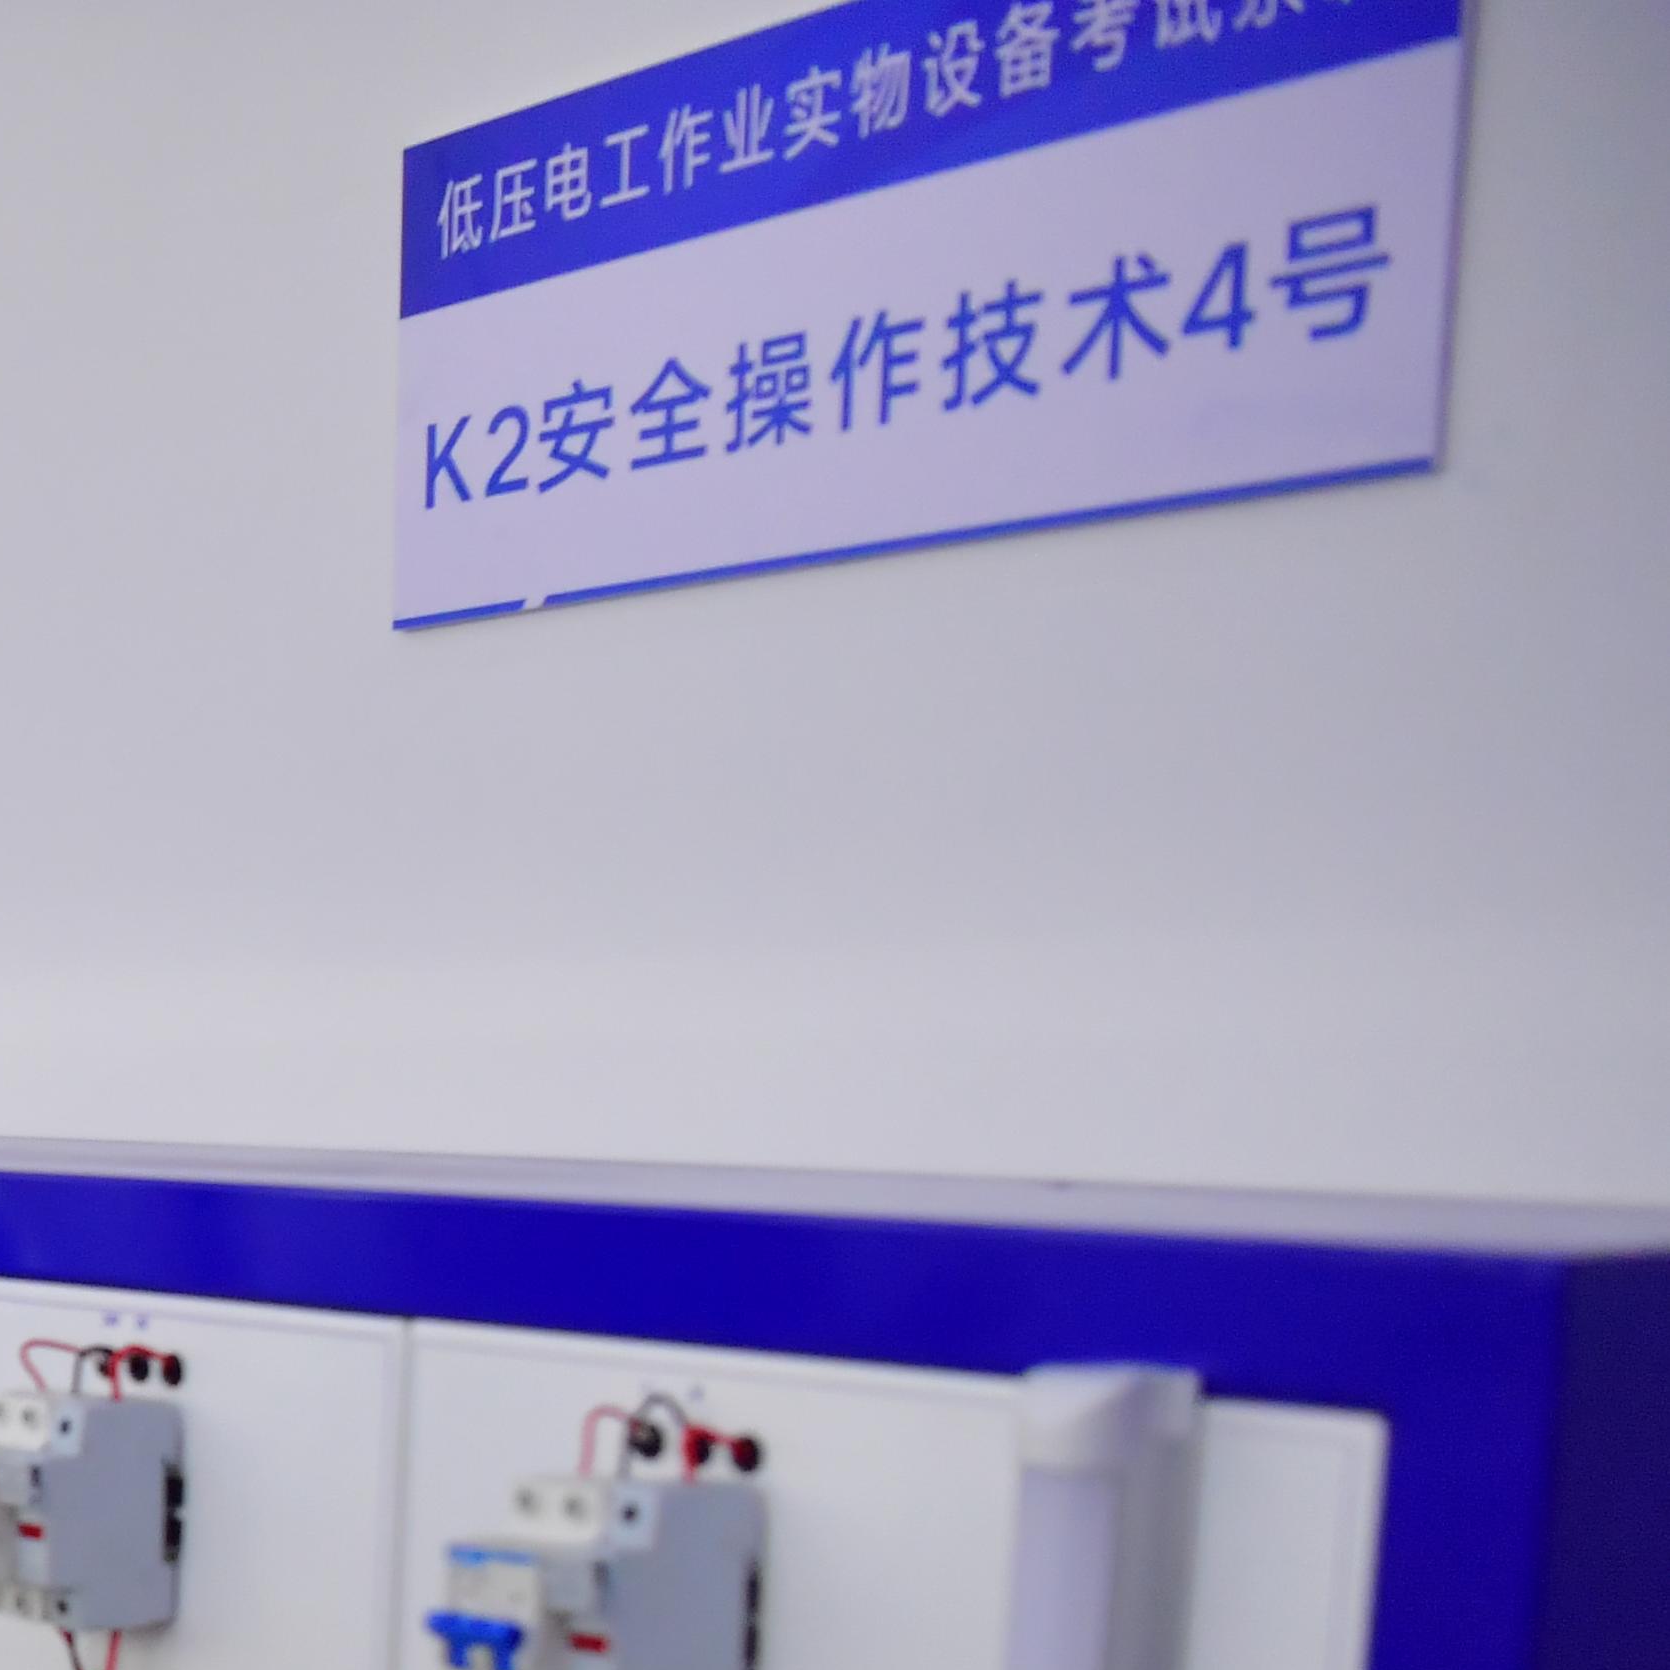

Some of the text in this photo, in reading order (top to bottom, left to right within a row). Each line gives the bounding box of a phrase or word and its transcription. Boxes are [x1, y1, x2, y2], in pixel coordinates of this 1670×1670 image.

[436, 0, 1355, 261] 低压电工作业实物设备考试
[422, 203, 1392, 511] K2安全操作技术4号
